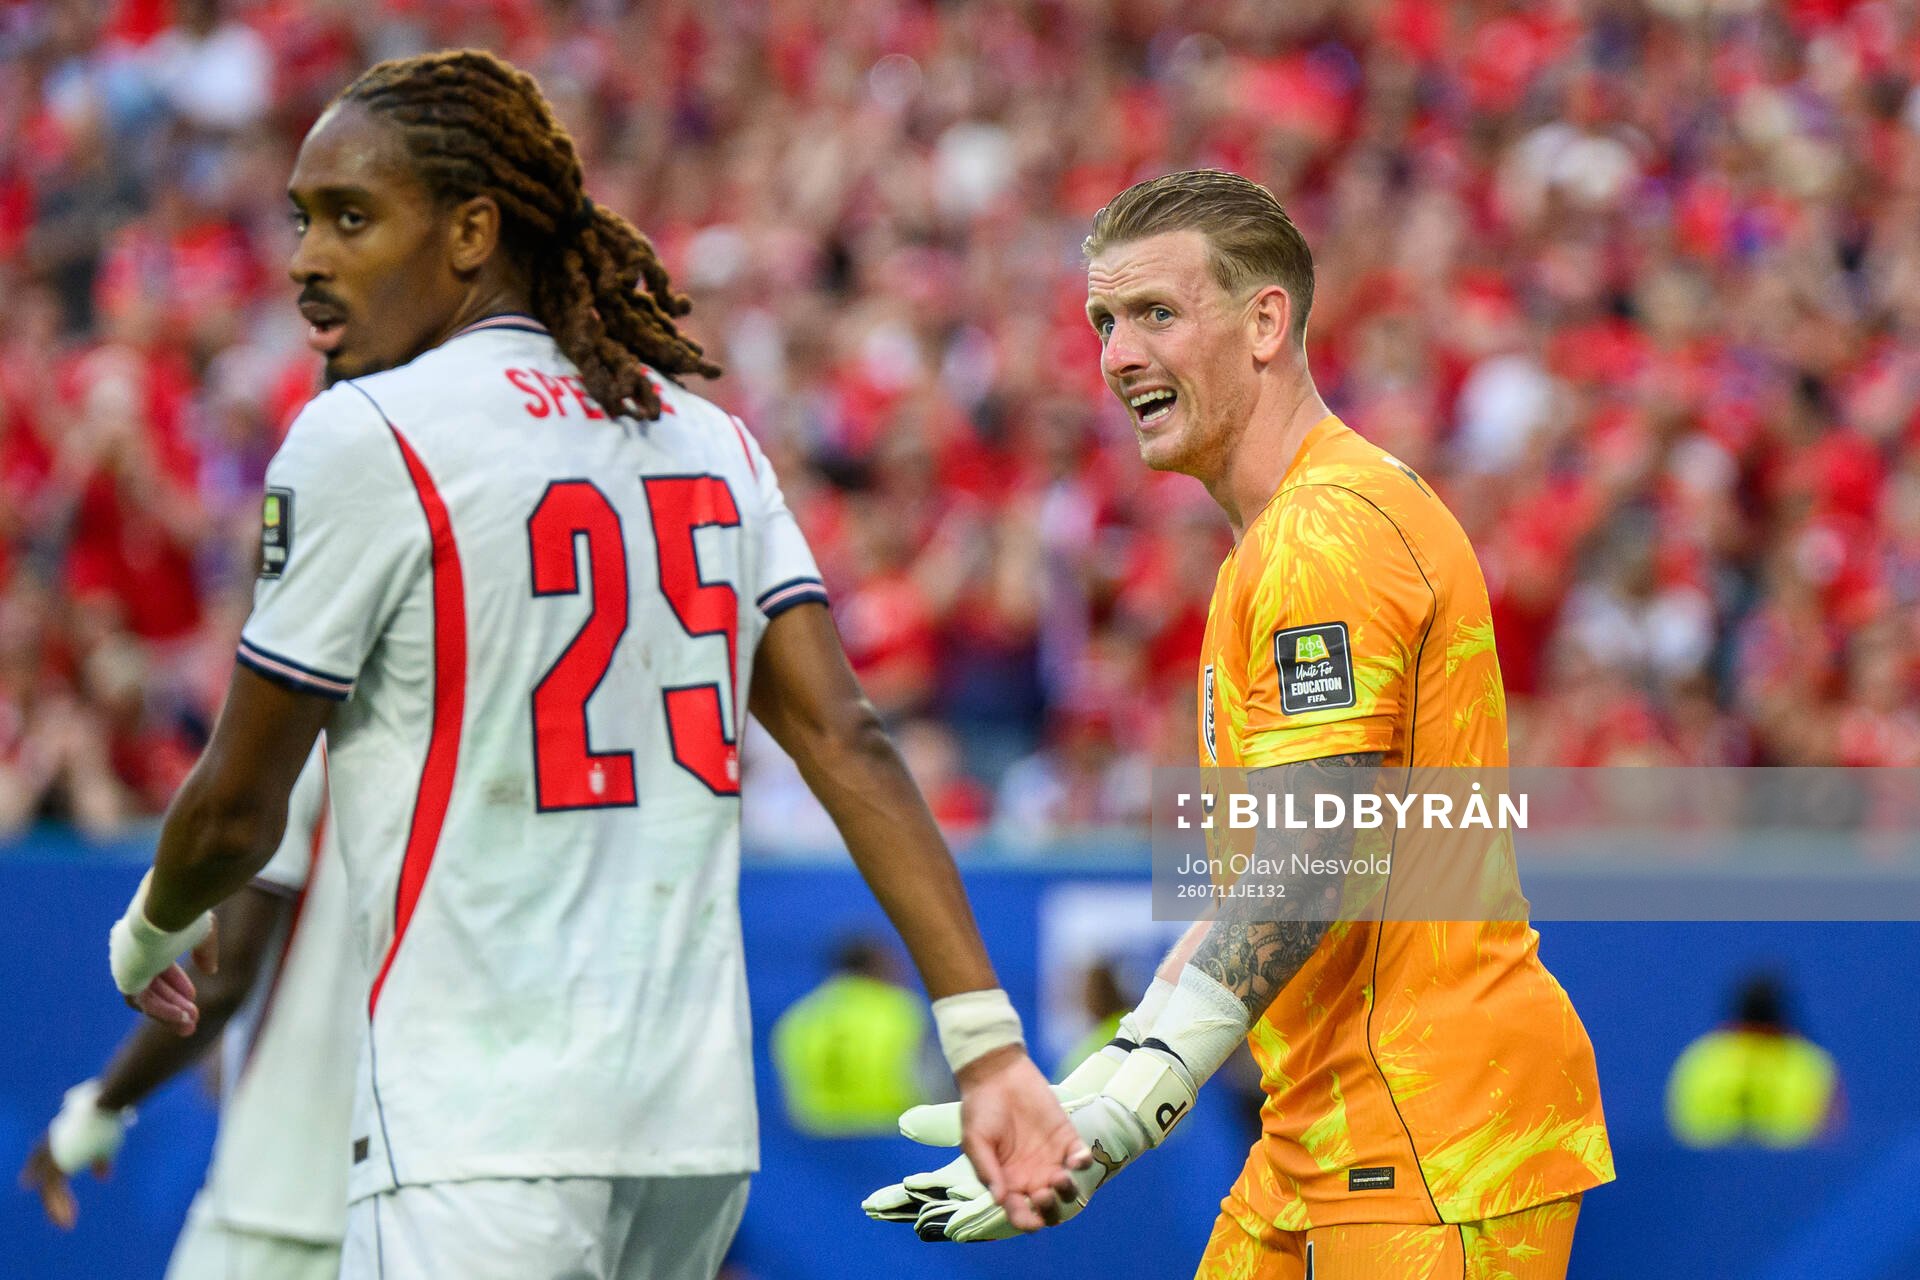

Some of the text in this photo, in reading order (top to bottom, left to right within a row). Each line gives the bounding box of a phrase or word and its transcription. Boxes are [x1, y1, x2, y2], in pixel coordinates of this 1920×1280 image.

[527, 473, 741, 812] 25
[1296, 661, 1333, 680] Unite For
[1291, 678, 1342, 696] EDUCATION
[1307, 694, 1327, 703] FIFA
